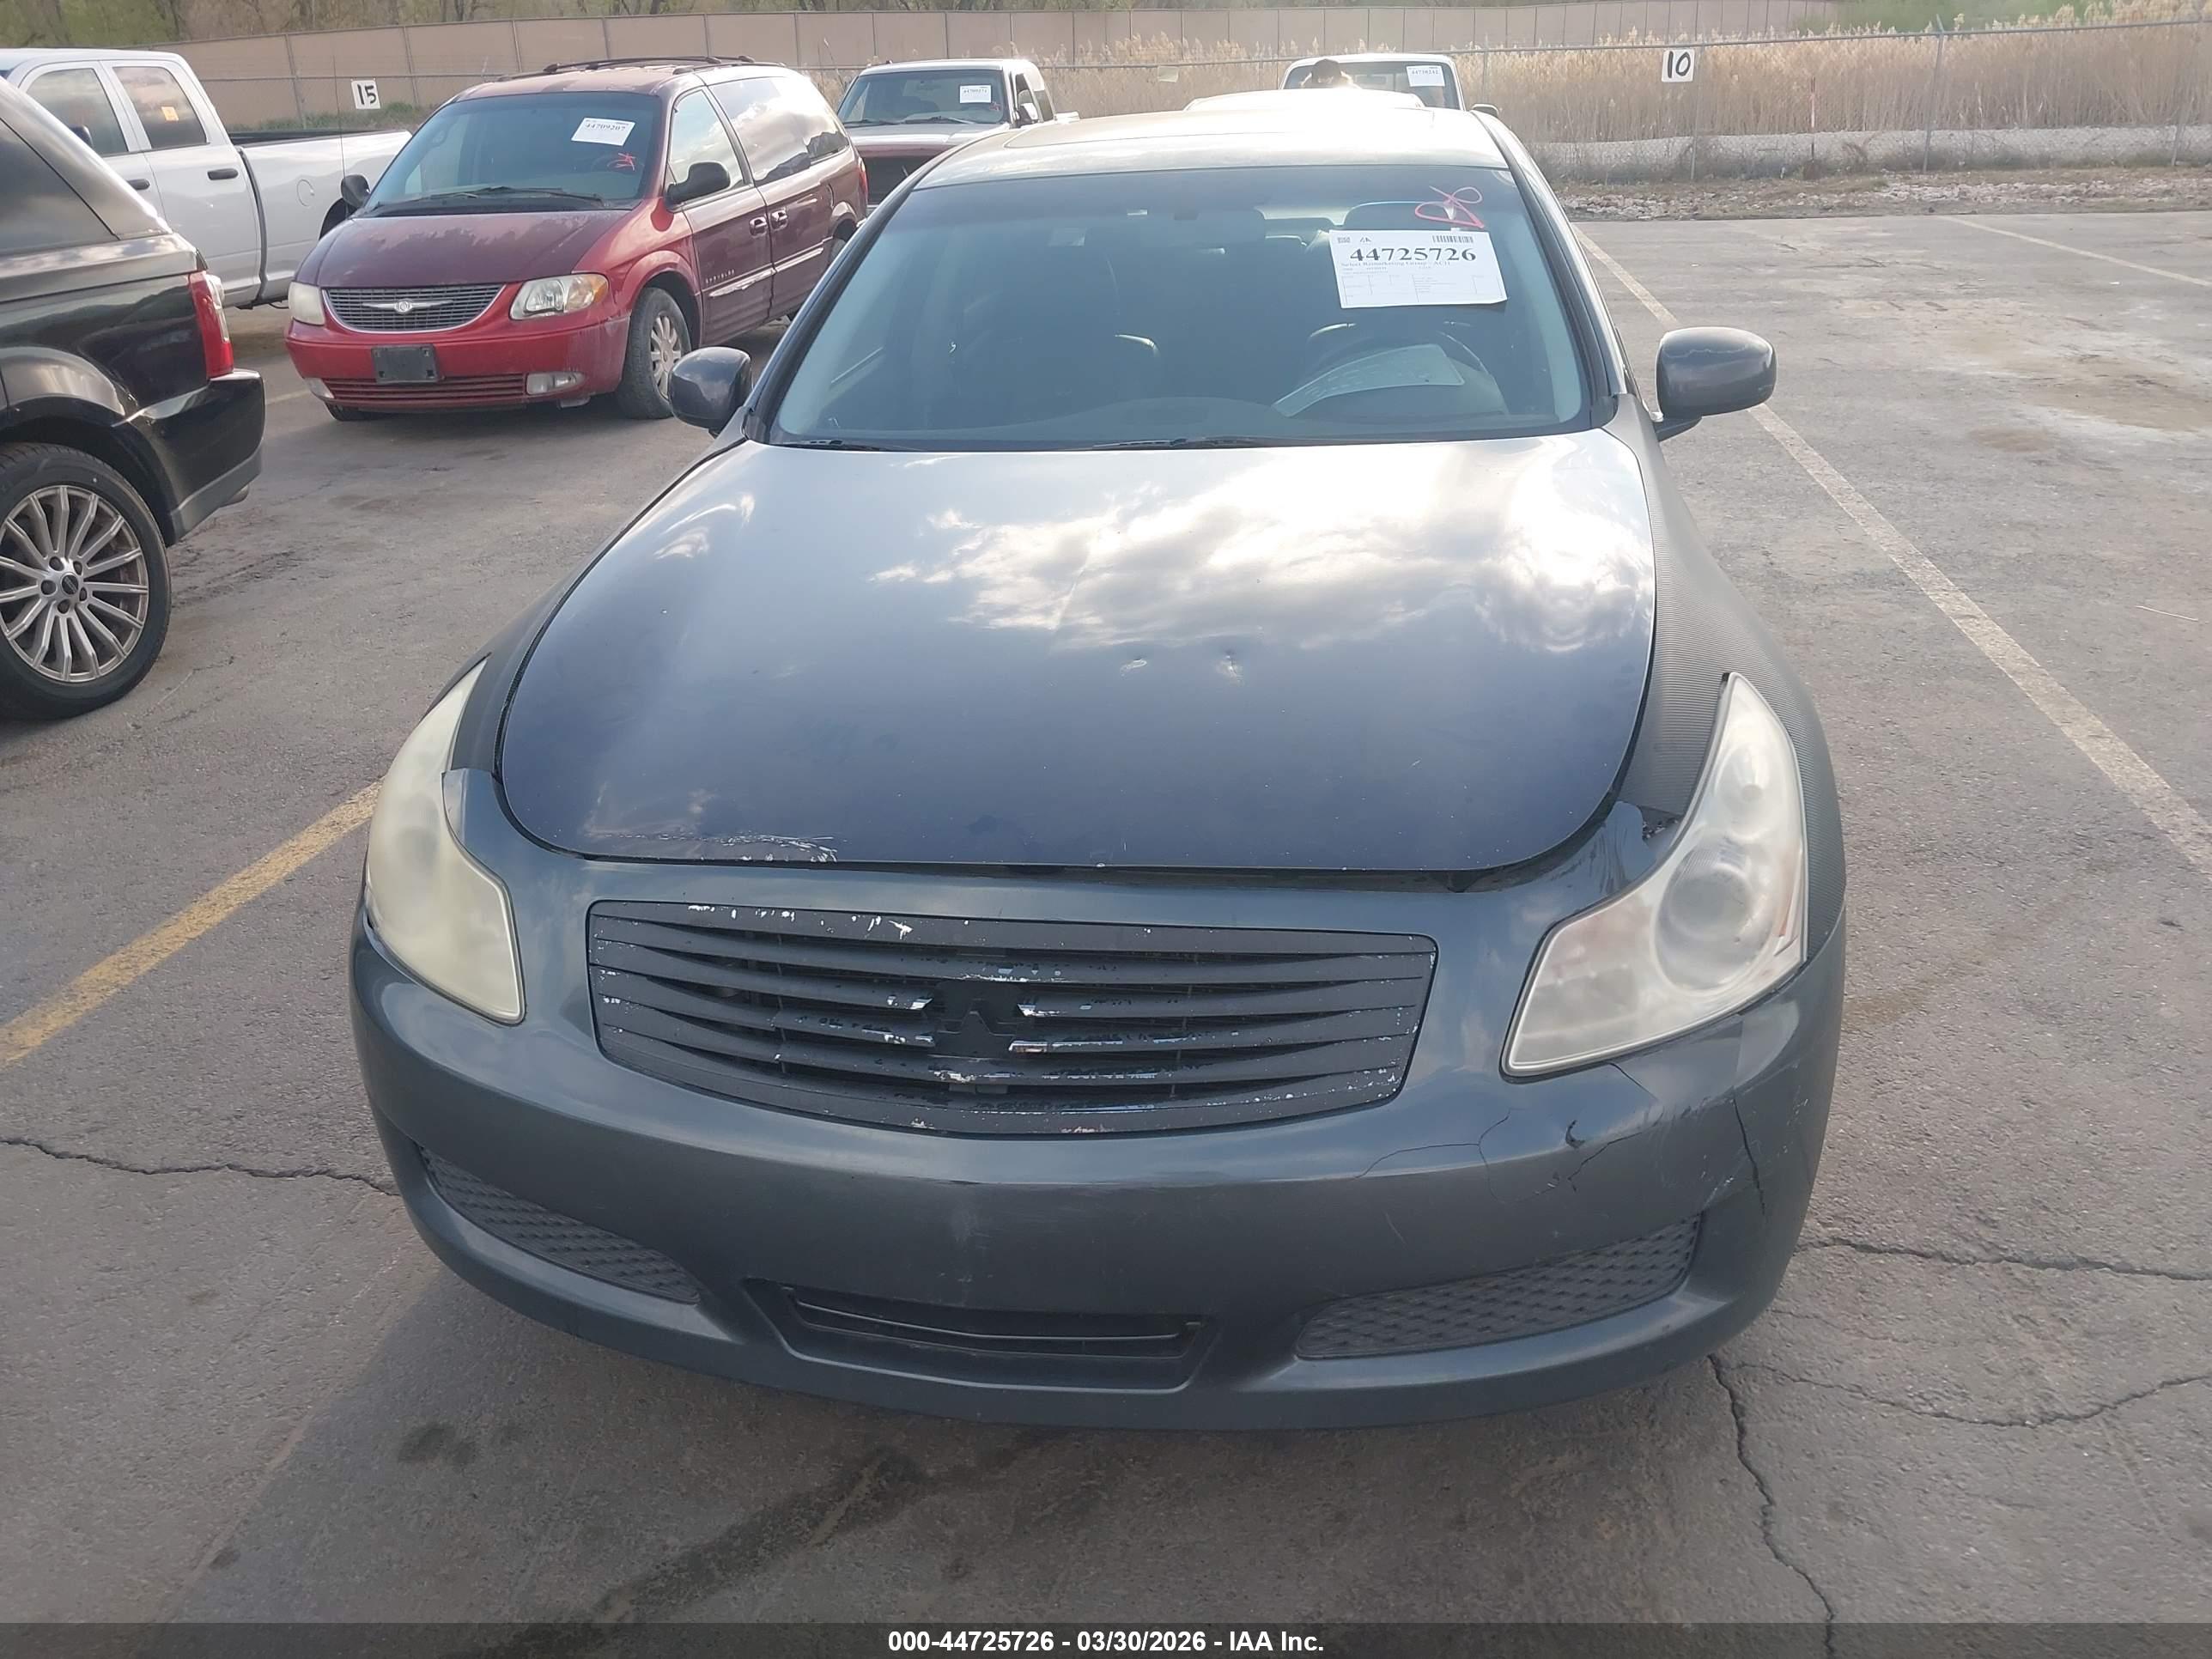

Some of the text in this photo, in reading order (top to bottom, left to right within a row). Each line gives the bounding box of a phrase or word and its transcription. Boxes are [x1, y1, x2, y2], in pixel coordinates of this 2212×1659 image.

[1668, 51, 1692, 78] 10
[357, 84, 377, 105] 15
[1350, 247, 1477, 261] 44725726
